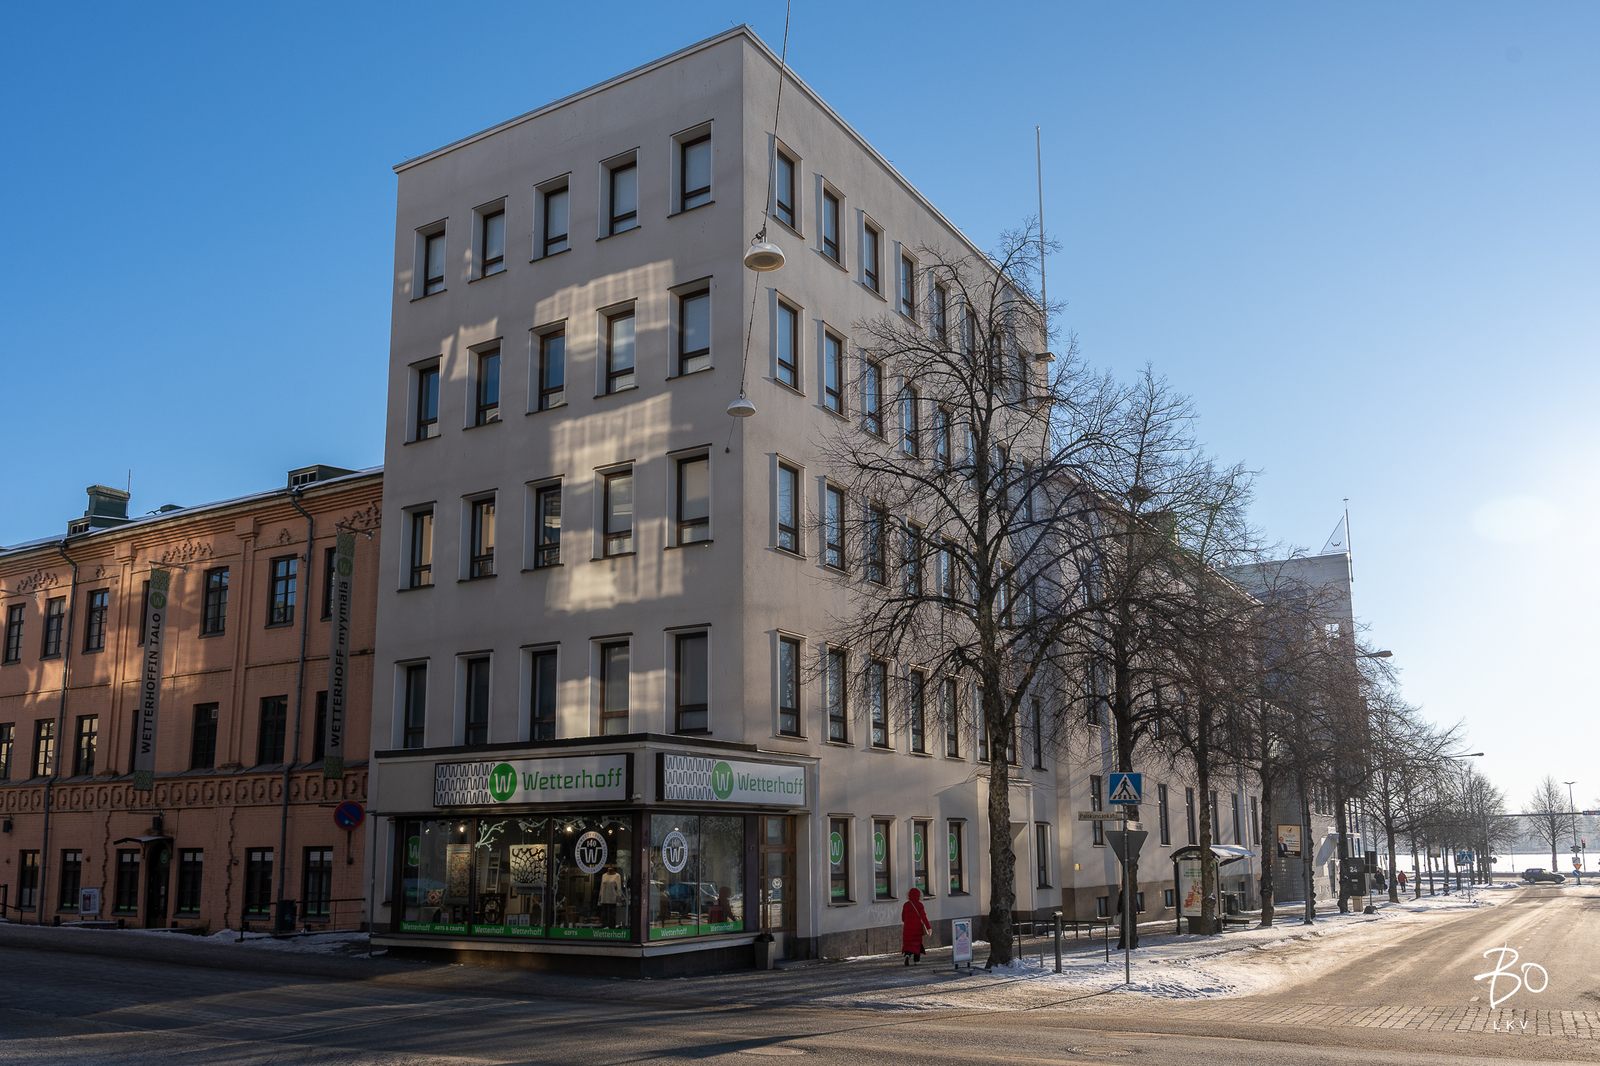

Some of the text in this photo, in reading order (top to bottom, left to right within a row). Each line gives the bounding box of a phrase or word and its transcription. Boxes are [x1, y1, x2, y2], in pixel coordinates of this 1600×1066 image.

[330, 581, 349, 748] WETTERHOFF myymälä
[141, 613, 161, 754] WETTERHOFFIN TALO
[494, 772, 513, 794] W
[521, 767, 623, 791] Wetterhoff
[736, 772, 803, 795] Wetterhoff
[586, 839, 597, 848] 140
[402, 922, 431, 931] Wetterhoff
[474, 925, 542, 936] Wetterhoff Wetterhoff
[660, 927, 688, 937] Wetterhoff
[710, 923, 734, 932] Wetterhoff
[592, 929, 627, 939] Wetterhoff
